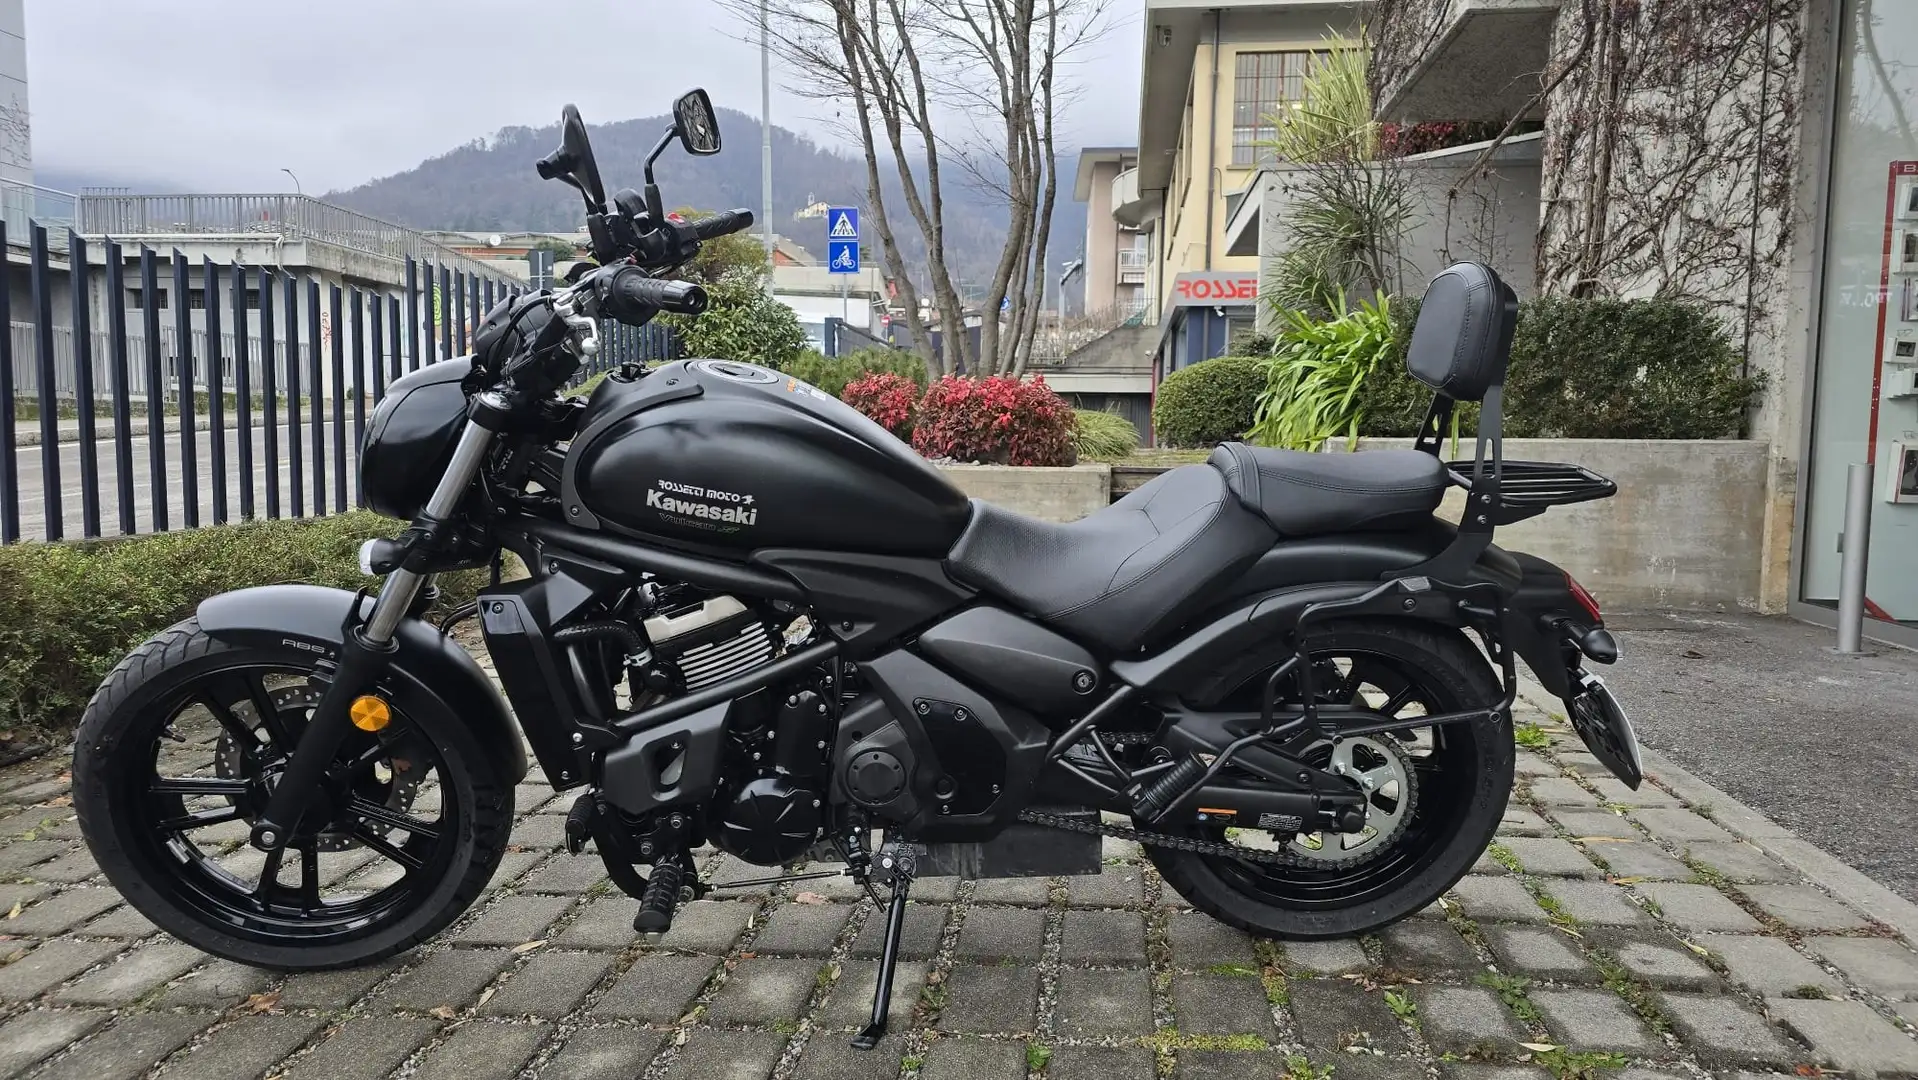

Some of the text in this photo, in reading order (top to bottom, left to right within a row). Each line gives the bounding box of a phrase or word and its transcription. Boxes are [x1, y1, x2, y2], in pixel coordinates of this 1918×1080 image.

[658, 479, 741, 502] ROSSETTI MOTO
[646, 488, 758, 526] Kawasaki
[282, 638, 325, 653] ABS
